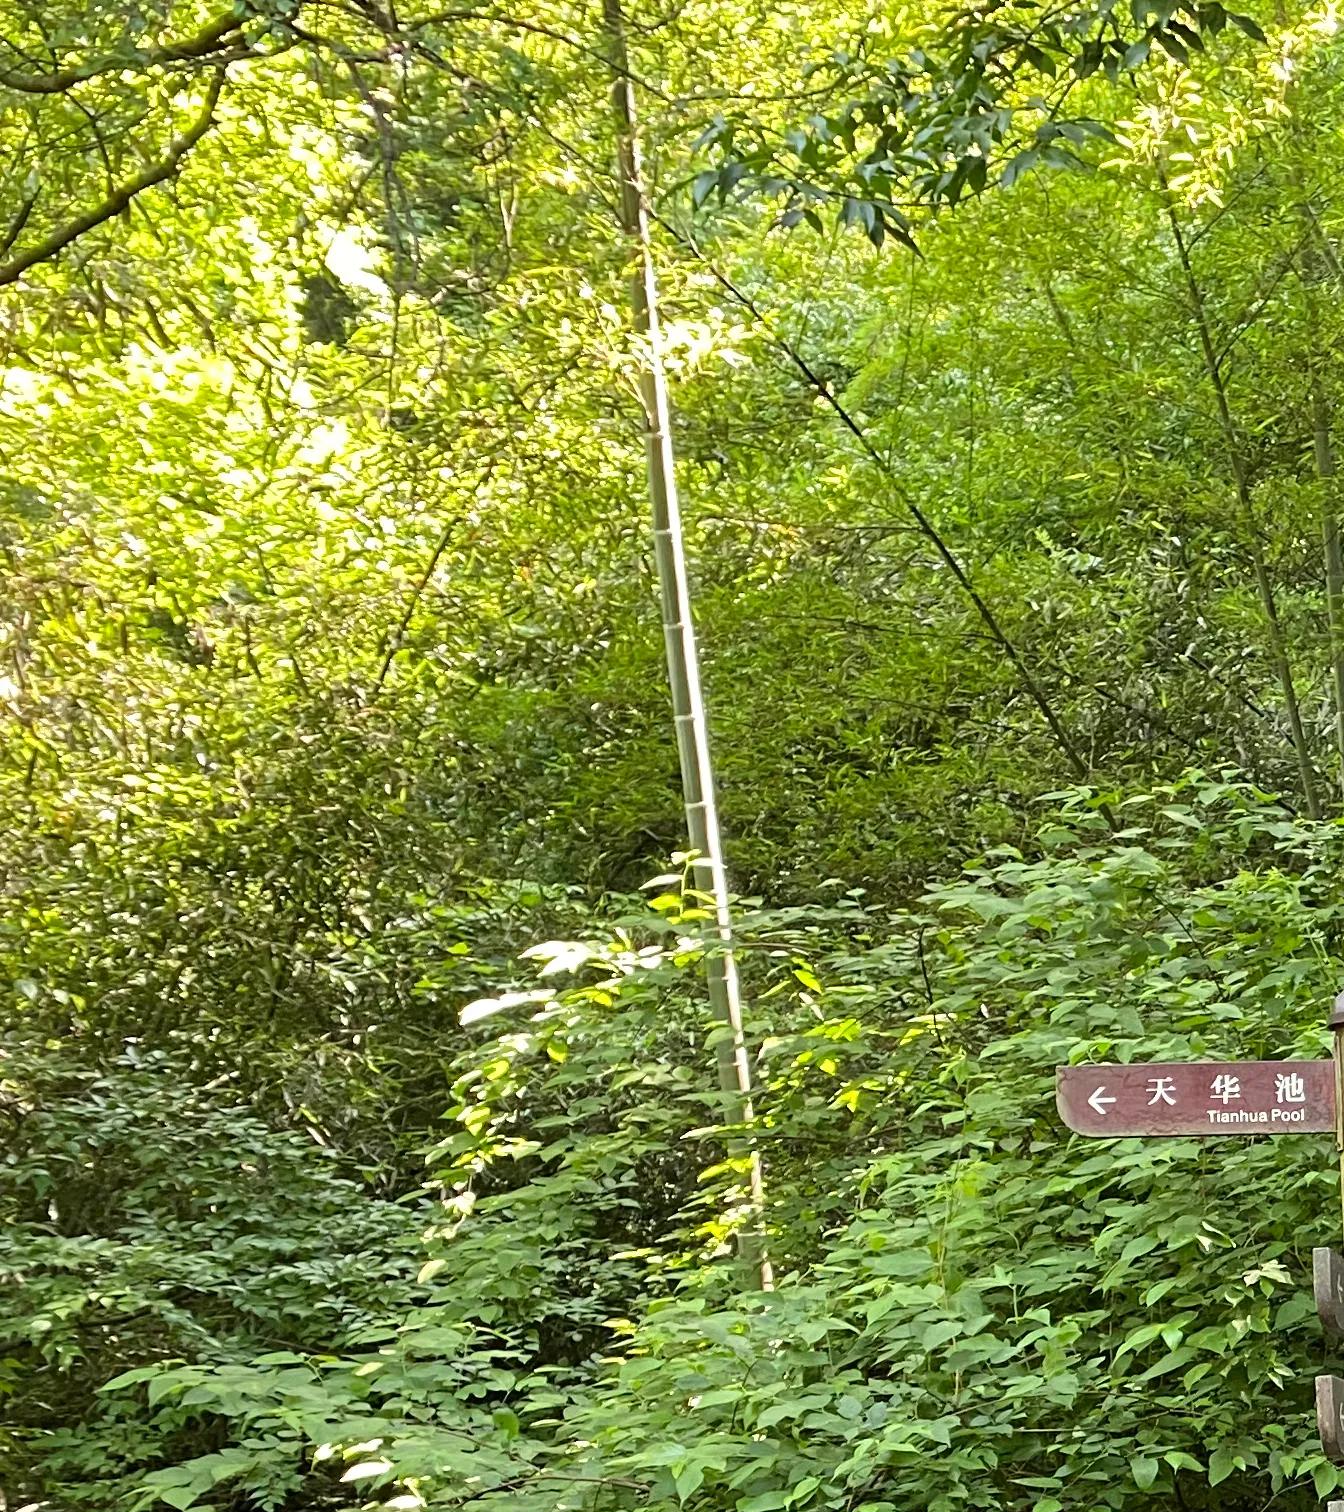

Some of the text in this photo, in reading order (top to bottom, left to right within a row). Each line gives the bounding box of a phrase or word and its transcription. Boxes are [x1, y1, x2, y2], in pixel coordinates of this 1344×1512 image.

[1145, 1073, 1306, 1105] 天华池
[1206, 1108, 1305, 1123] Tianhua Pool
